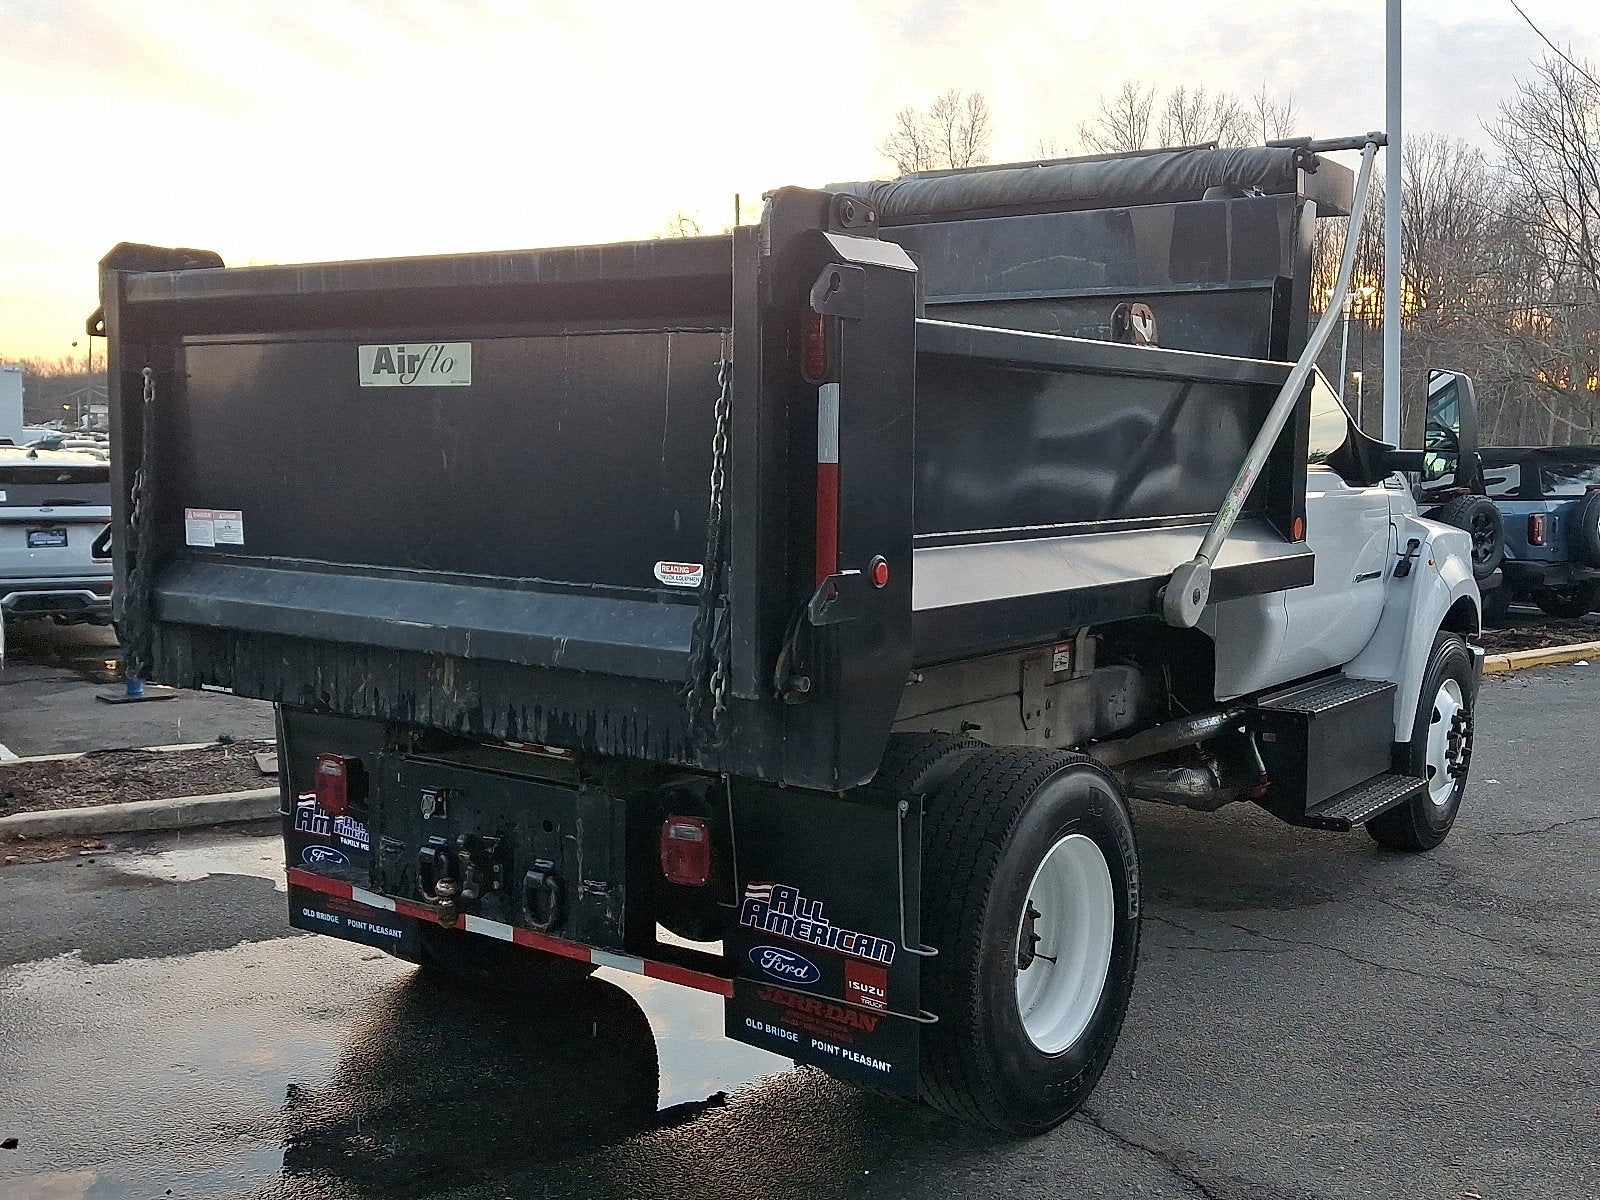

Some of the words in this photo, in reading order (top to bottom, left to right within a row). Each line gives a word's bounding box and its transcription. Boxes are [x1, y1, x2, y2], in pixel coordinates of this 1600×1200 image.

[372, 345, 454, 385] Airflo
[661, 564, 690, 574] READING
[340, 836, 360, 849] FAMILY
[769, 883, 830, 926] ALL
[302, 907, 315, 919] OLD
[316, 911, 340, 924] BRIDGE
[347, 918, 368, 931] POINT
[368, 923, 403, 939] PLEASANT
[739, 897, 896, 965] AMERICAN
[760, 950, 809, 979] Ford
[848, 980, 885, 997] ISUZU
[860, 997, 884, 1010] TRUCK
[745, 1017, 764, 1031] OLD
[765, 1023, 800, 1043] BRIDGE
[811, 1038, 841, 1056] POINT
[842, 1048, 893, 1073] PLEASANT
